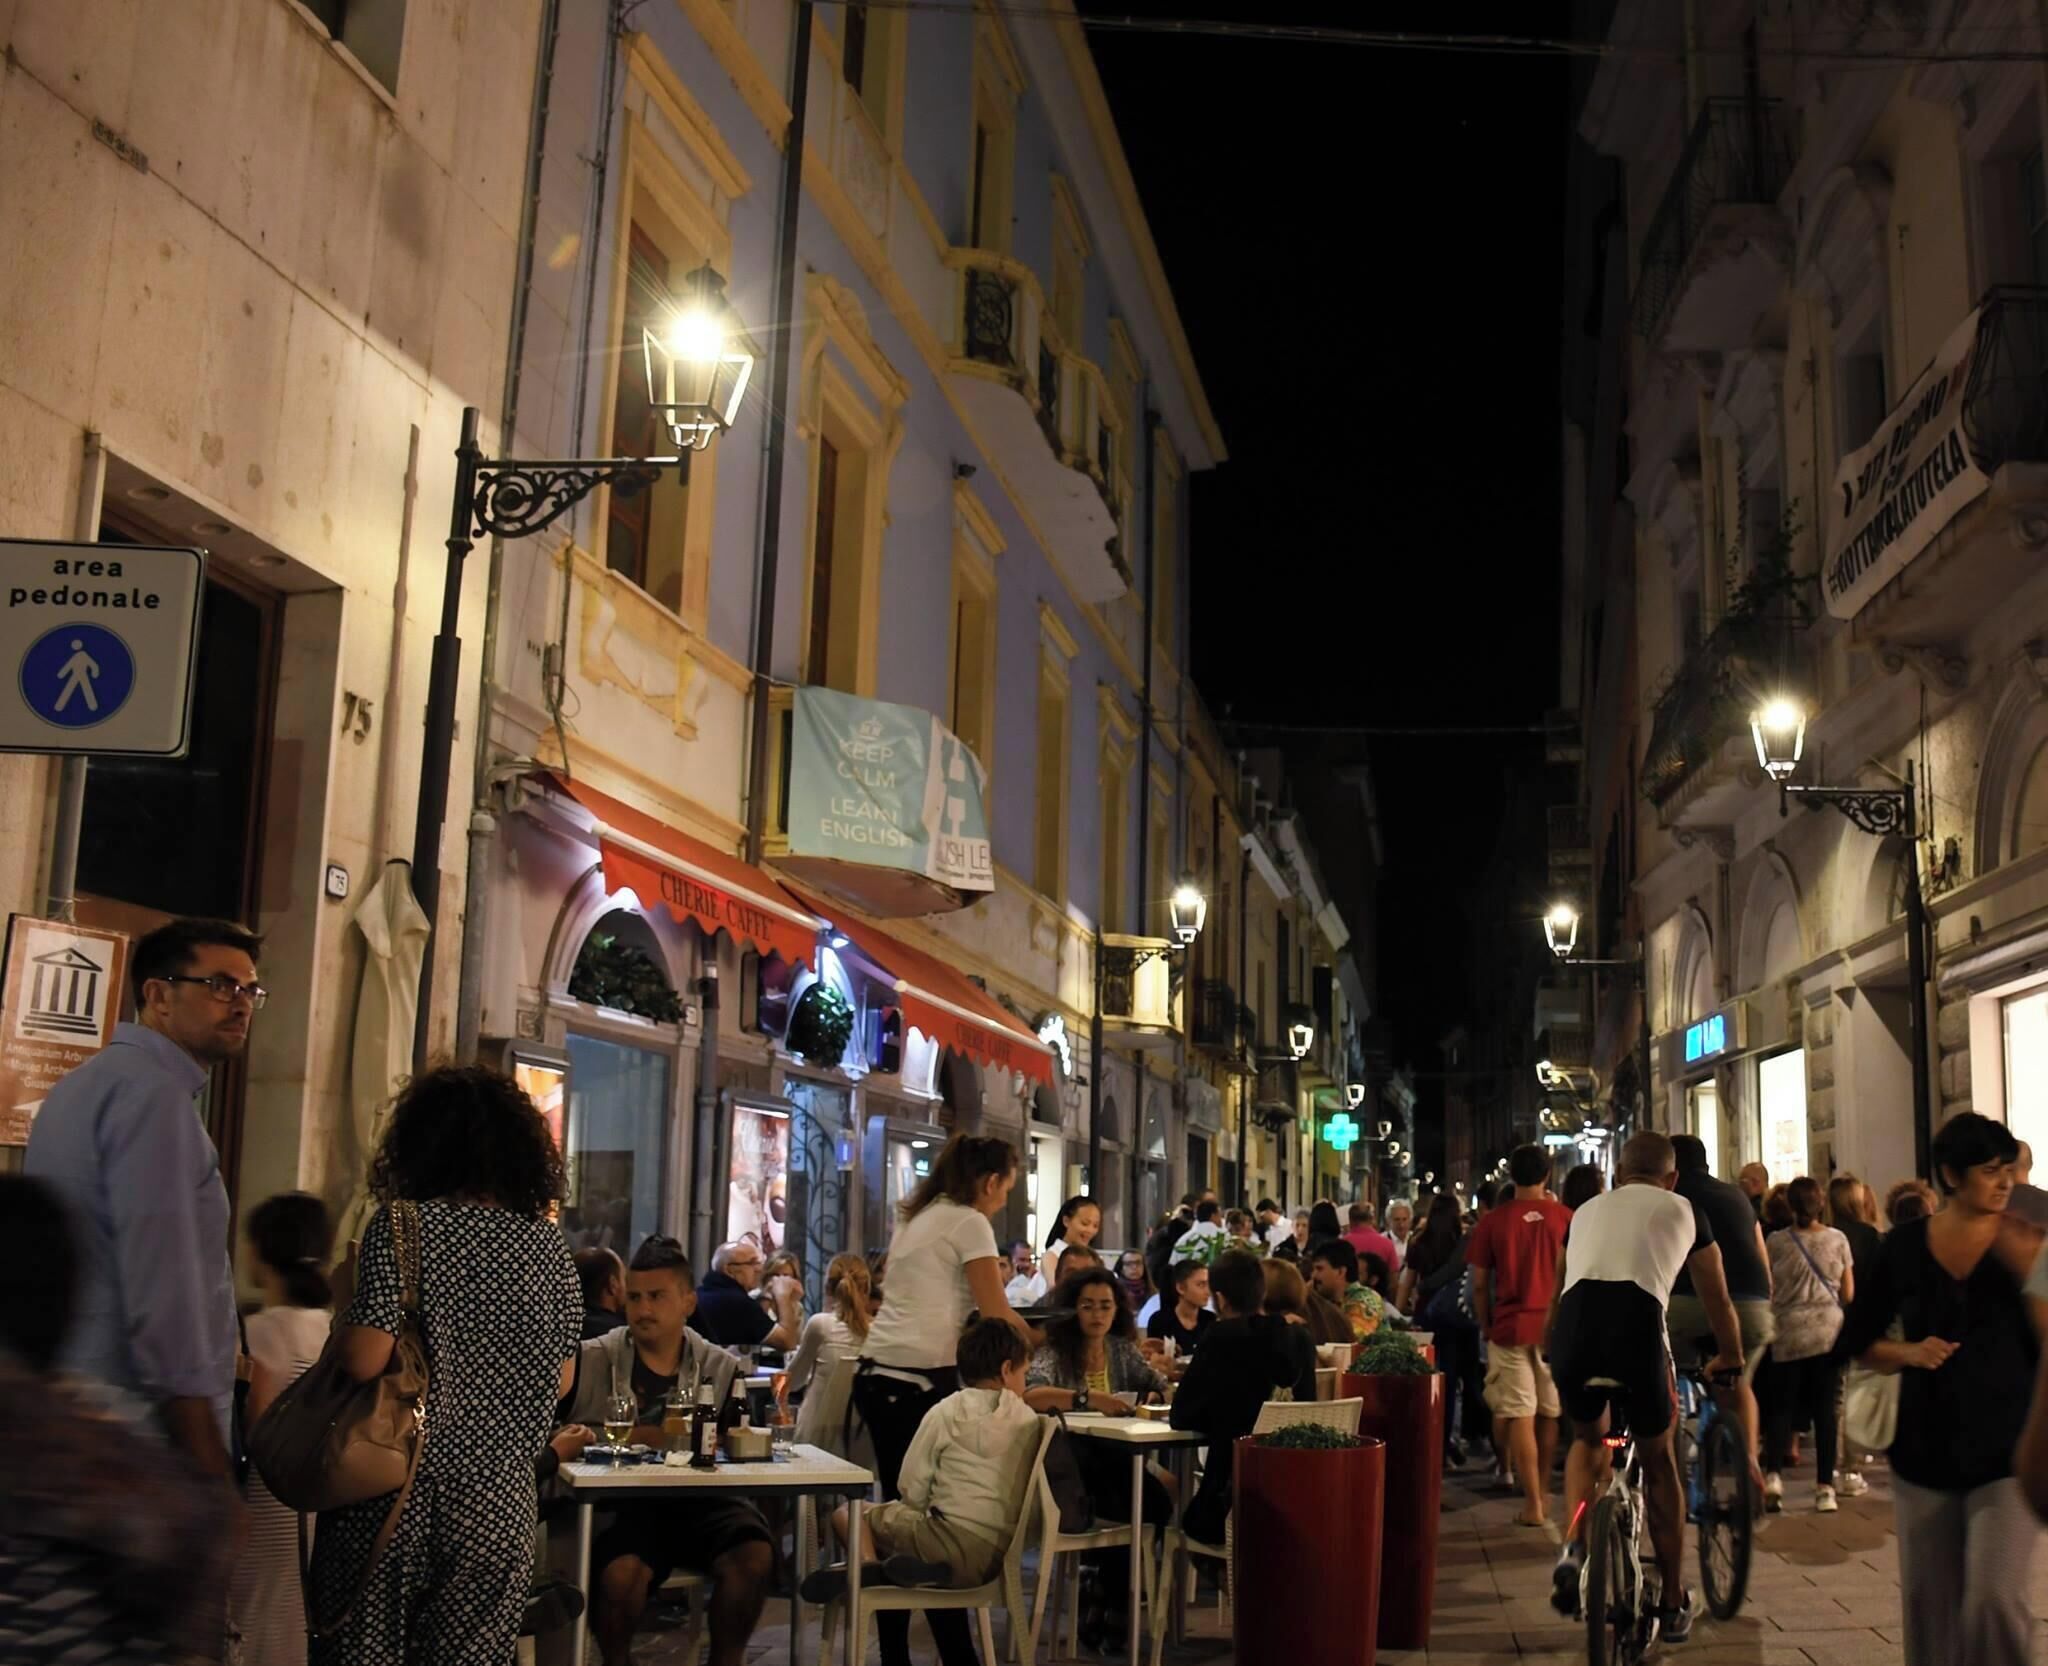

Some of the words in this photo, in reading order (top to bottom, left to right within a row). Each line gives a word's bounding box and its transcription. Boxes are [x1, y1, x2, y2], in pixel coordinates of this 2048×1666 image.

[54, 559, 122, 577] area
[9, 585, 160, 608] pedonale
[341, 691, 374, 745] 75
[661, 871, 721, 920] CHERIE
[63, 1049, 83, 1062] Arb
